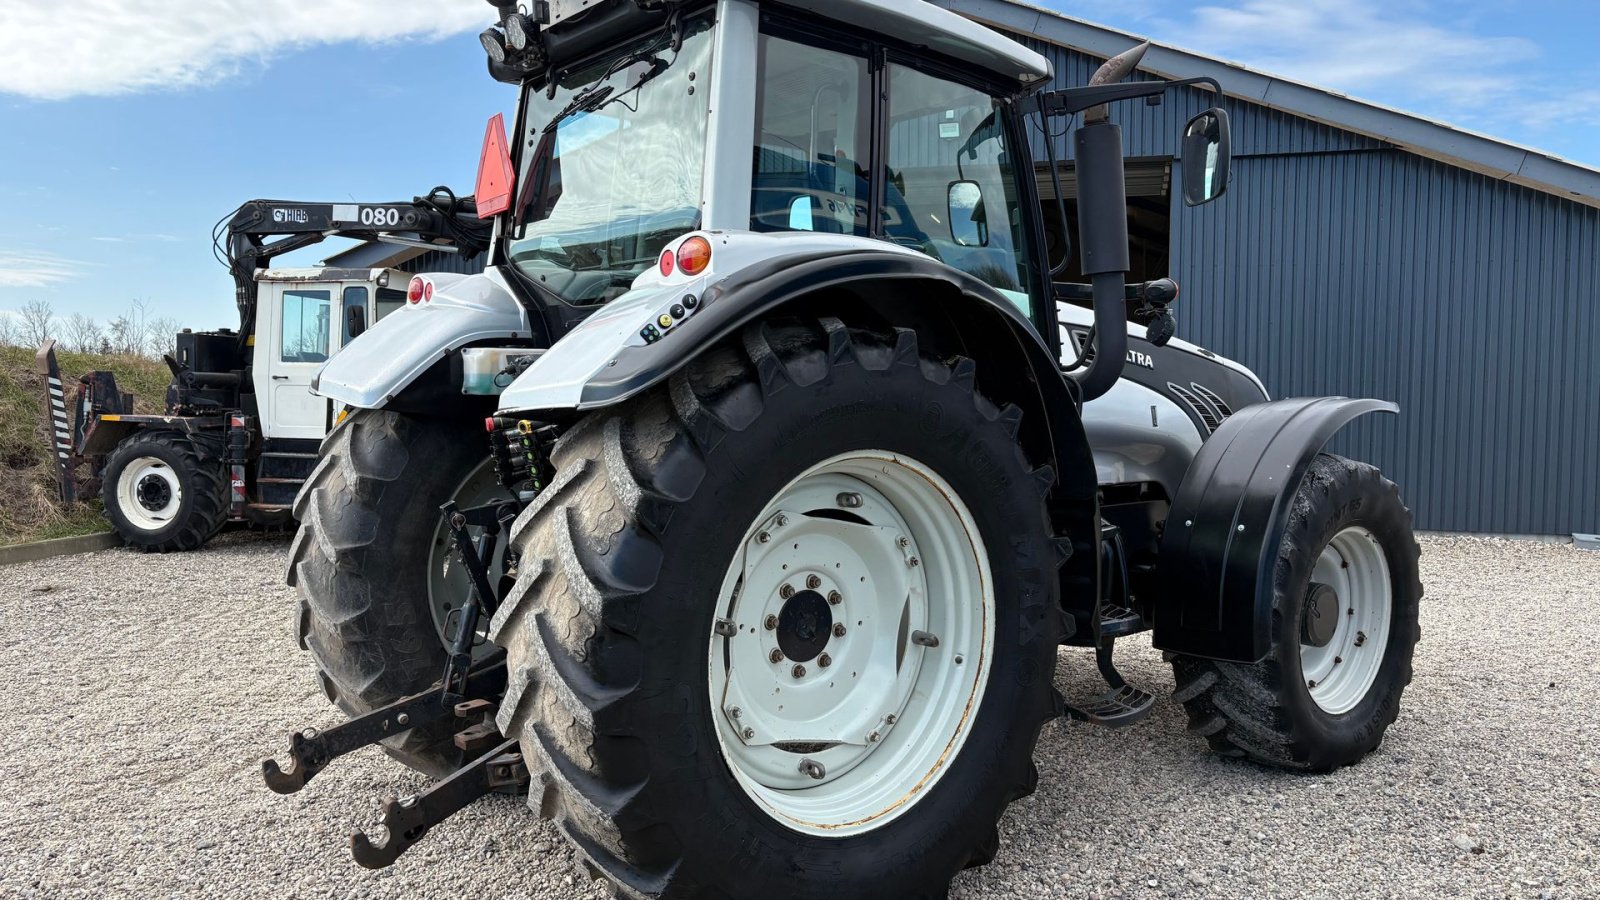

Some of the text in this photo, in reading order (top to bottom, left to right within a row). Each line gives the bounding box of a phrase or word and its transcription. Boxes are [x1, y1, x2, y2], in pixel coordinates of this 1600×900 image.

[361, 207, 399, 226] 080
[1126, 350, 1154, 368] LTRA
[1364, 722, 1373, 737] R
